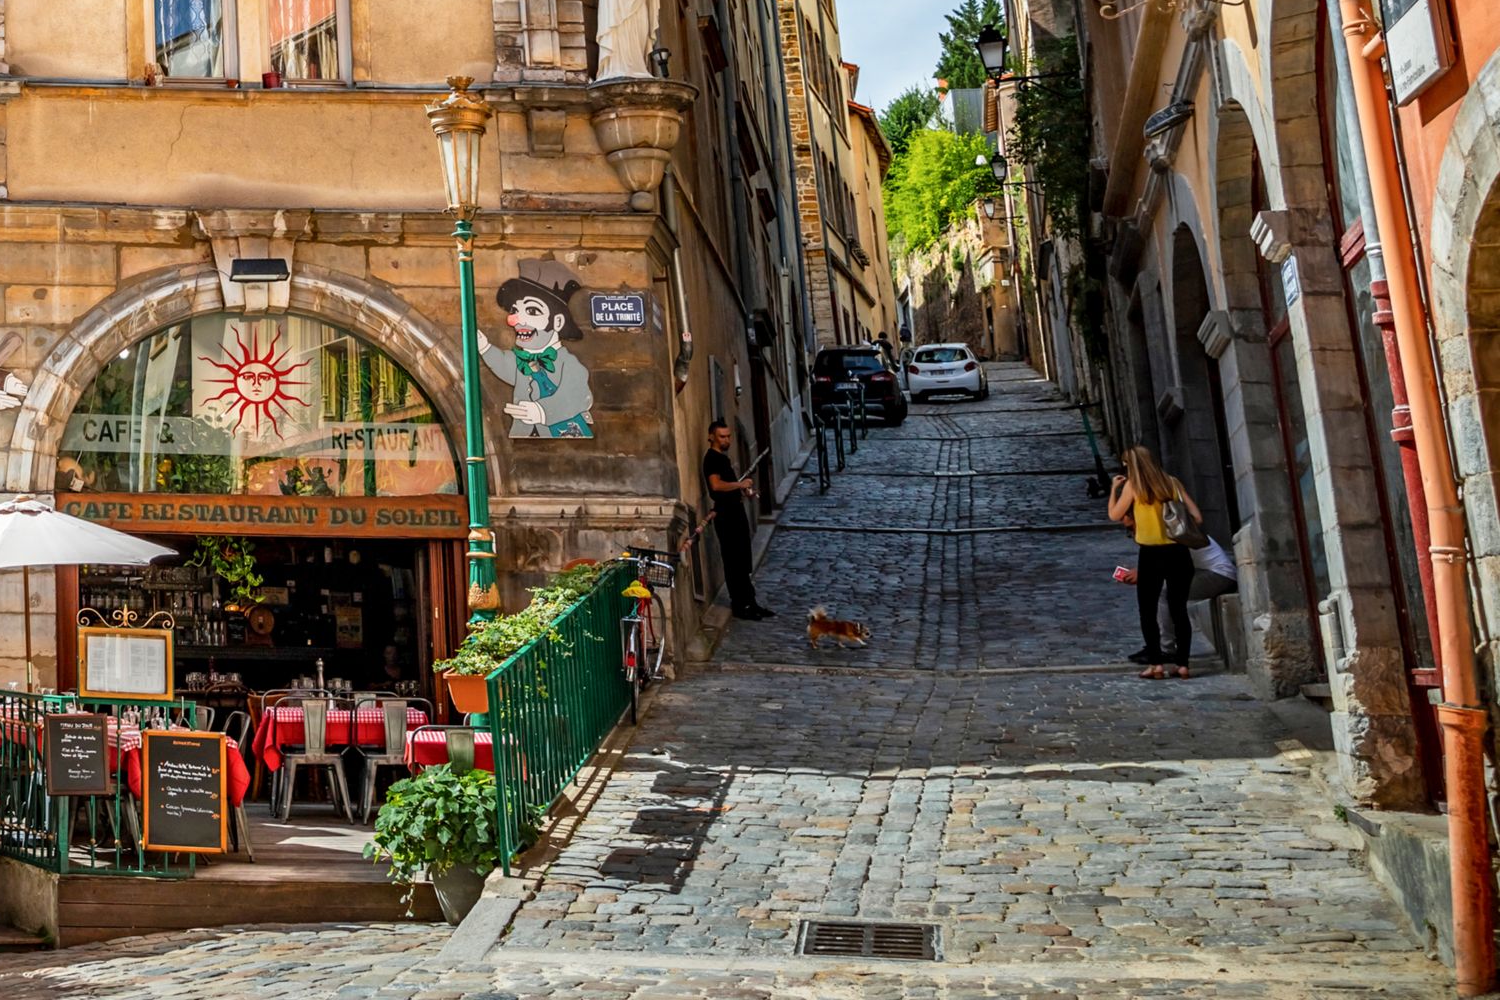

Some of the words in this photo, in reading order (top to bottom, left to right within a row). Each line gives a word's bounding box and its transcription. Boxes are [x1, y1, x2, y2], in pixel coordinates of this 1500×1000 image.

[601, 302, 634, 311] PLACE
[595, 313, 604, 321] DE
[616, 312, 641, 321] TRINITÉ
[157, 422, 175, 444] &
[332, 427, 444, 451] RESTAURANT
[64, 501, 132, 521] CAFE
[140, 503, 318, 525] RESTAURANT
[330, 506, 366, 526] DU
[376, 507, 461, 527] SOLEIL
